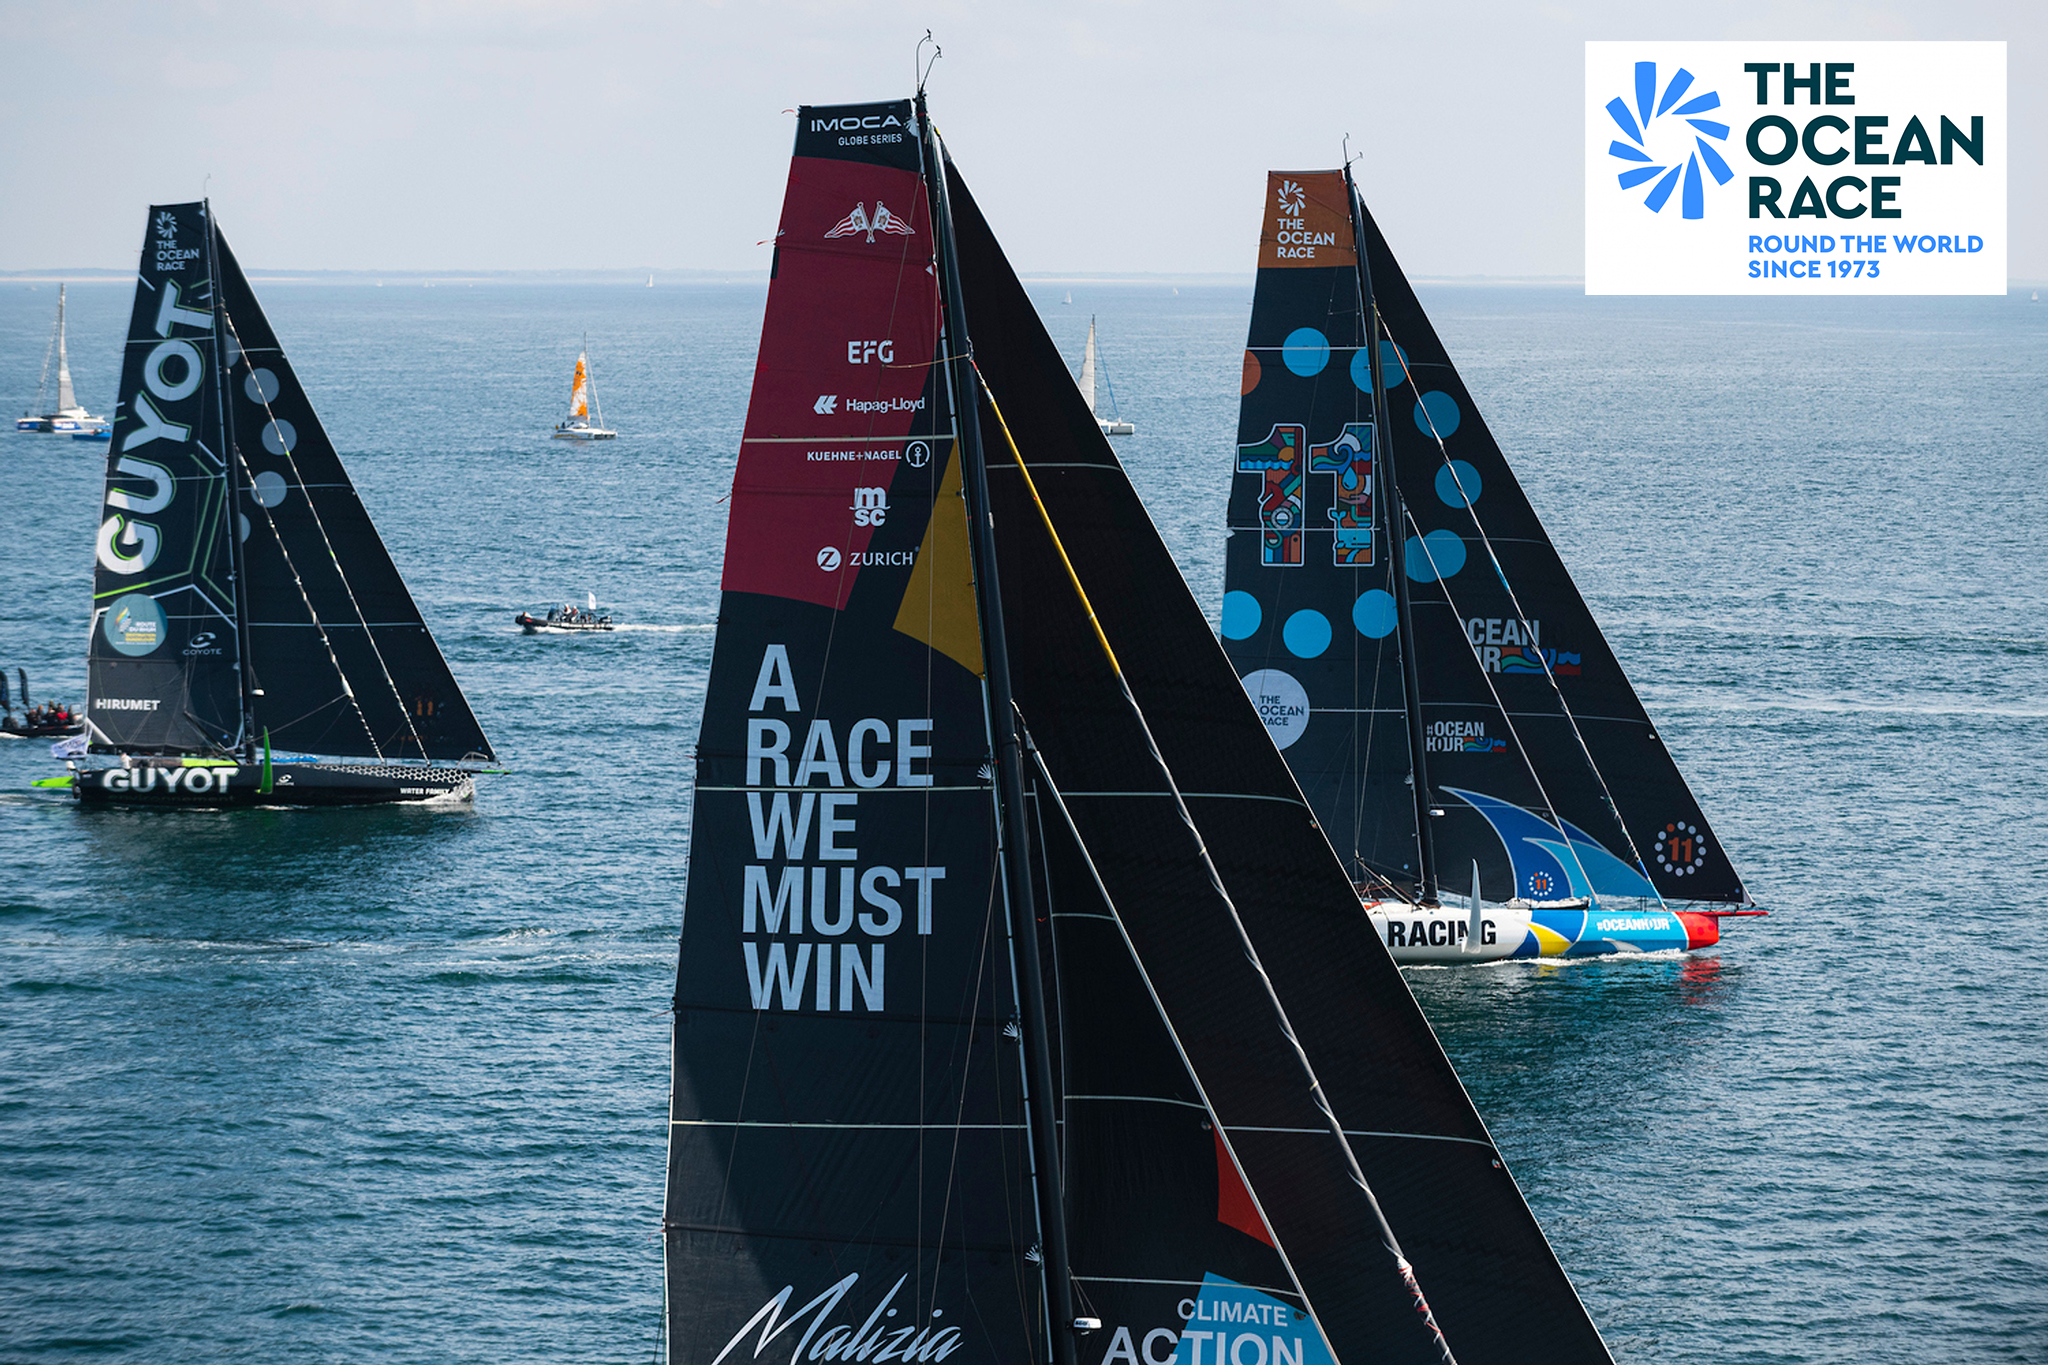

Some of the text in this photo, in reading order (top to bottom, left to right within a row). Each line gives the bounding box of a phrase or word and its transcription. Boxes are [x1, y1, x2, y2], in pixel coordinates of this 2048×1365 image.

[811, 115, 902, 132] IMOCA
[838, 133, 903, 146] GLOBE SERIES
[1277, 218, 1305, 230] THE
[156, 240, 177, 250] THE
[1277, 231, 1335, 246] OCEAN
[156, 248, 200, 261] OCEAN
[1277, 247, 1315, 258] RACE
[156, 261, 186, 271] RACE
[847, 340, 894, 364] EFG
[845, 397, 926, 414] Hapag-Lloyd
[97, 278, 214, 576] GUYOT
[806, 450, 902, 461] KUEHNE+NAGEL
[1235, 422, 1376, 567] 11
[849, 552, 914, 566] ZURICH
[182, 648, 222, 656] COYOTE
[748, 643, 801, 713] A
[95, 698, 160, 711] HIRUMET
[1260, 695, 1281, 704] THE
[1260, 705, 1305, 717] OCEAN
[1426, 721, 1485, 737] #OCEAN
[745, 718, 935, 788] RACE
[103, 767, 239, 794] GUYOT
[746, 792, 859, 861] WE
[1668, 837, 1692, 862] 11
[1535, 879, 1547, 890] 11
[742, 865, 947, 937] MUST
[742, 941, 886, 1012] WIN
[711, 1272, 965, 1365] Malizia
[1177, 1298, 1289, 1327] CLIMATE
[1100, 1326, 1305, 1365] ACTION
